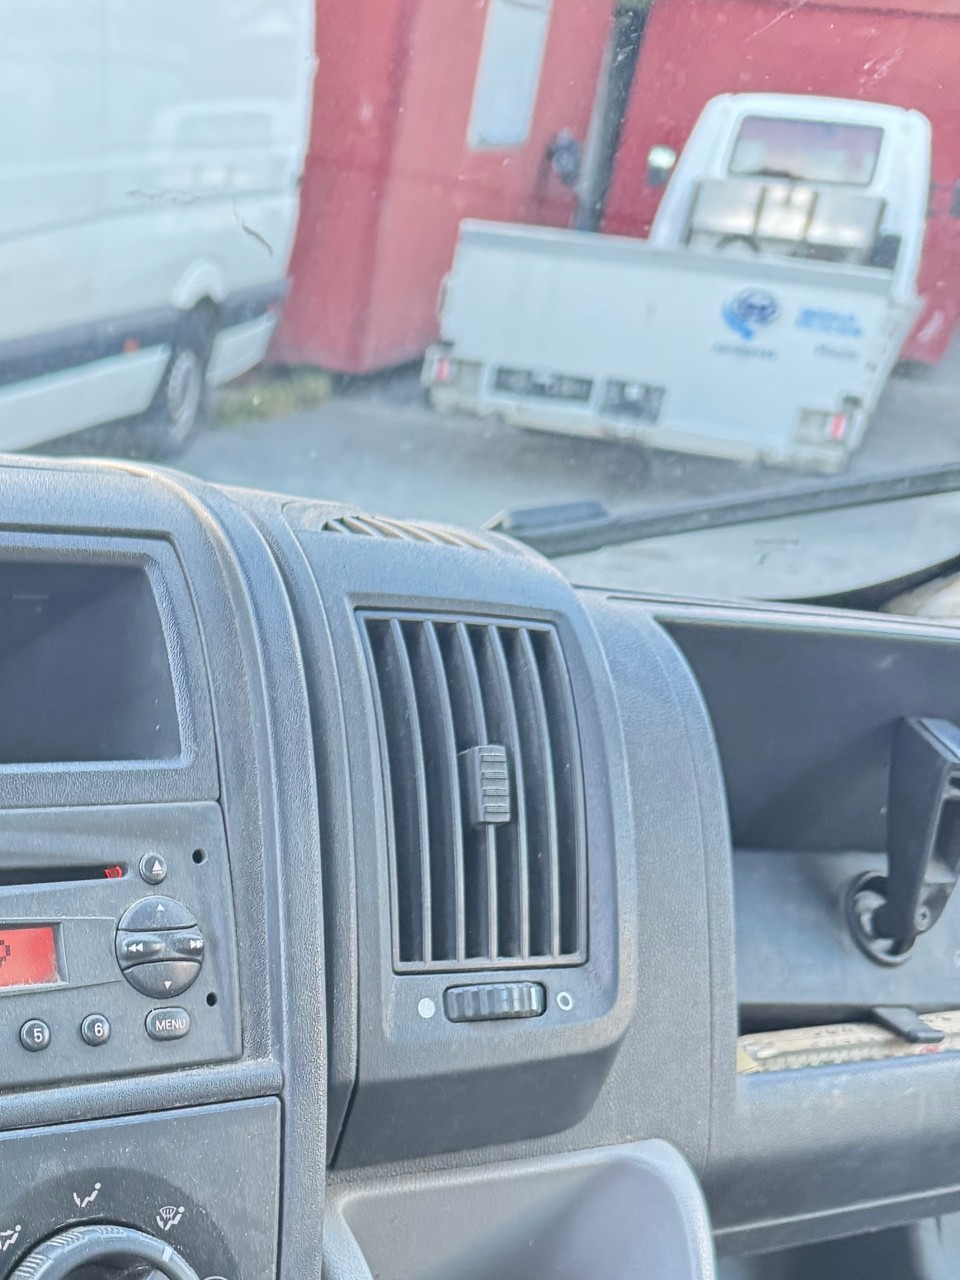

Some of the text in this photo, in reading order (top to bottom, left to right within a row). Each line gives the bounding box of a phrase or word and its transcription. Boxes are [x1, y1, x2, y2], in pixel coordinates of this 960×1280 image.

[93, 1022, 104, 1038] 6
[155, 1017, 187, 1032] MENU
[33, 1027, 43, 1043] 5
